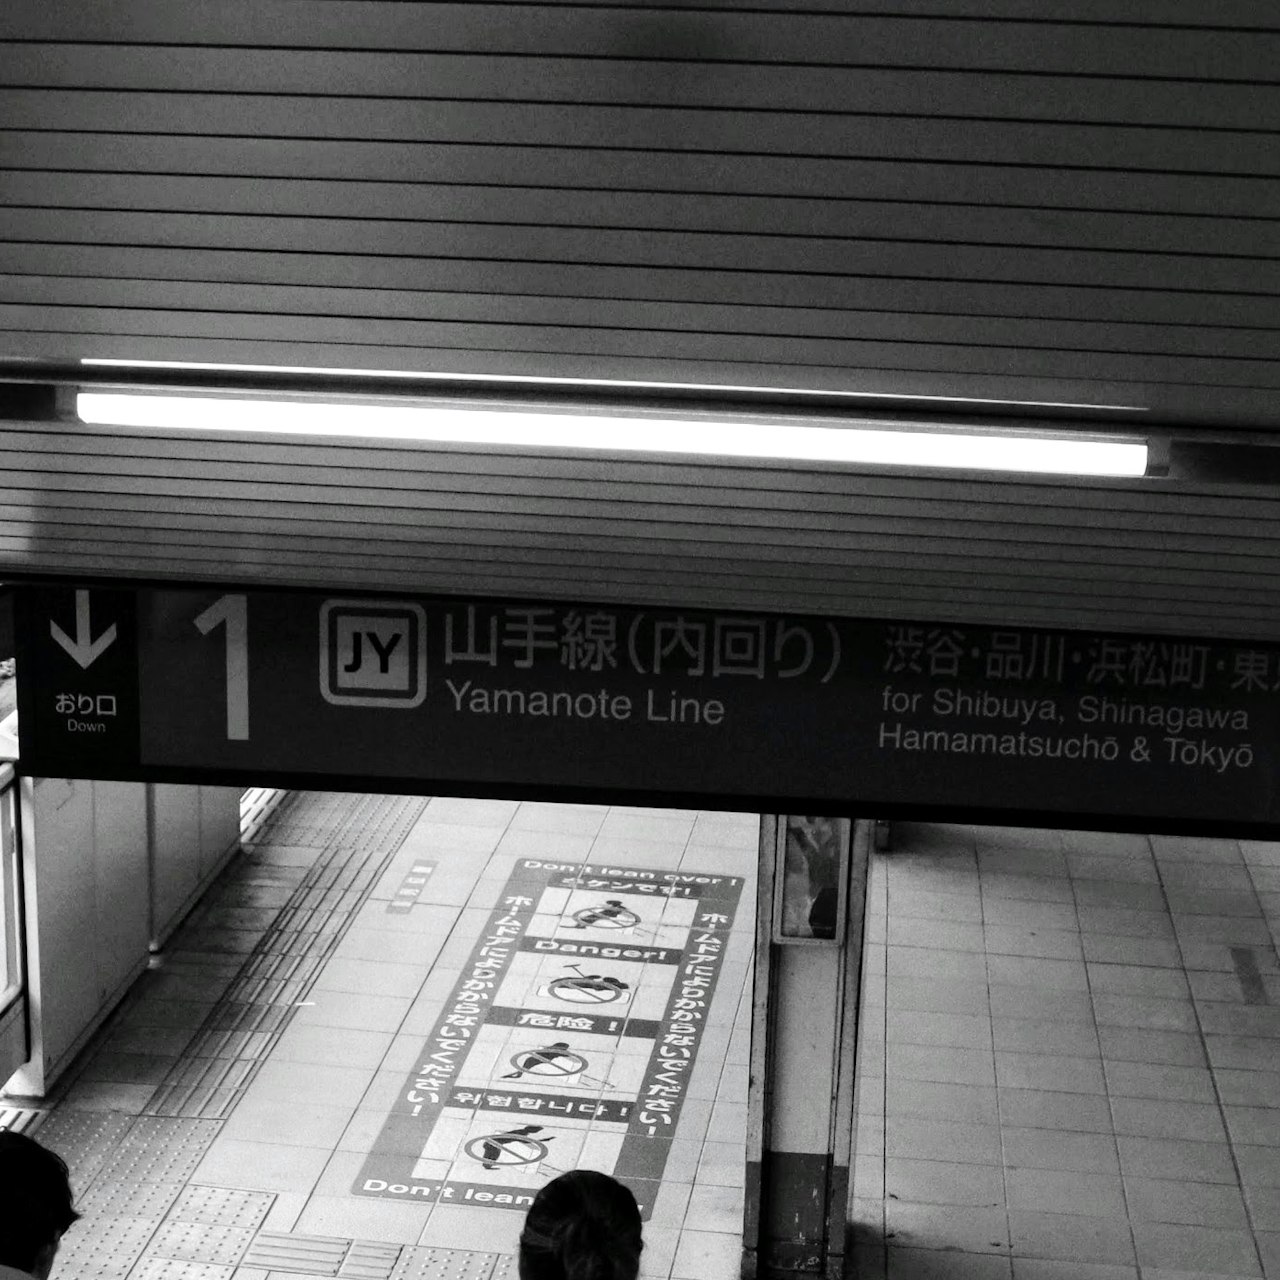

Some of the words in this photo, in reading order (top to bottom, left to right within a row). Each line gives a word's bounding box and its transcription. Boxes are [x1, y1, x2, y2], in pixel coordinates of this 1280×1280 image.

[344, 632, 402, 674] JY
[444, 604, 842, 684] 山手線(内回り)
[193, 594, 250, 741] 1
[55, 693, 117, 717] おり口
[445, 678, 633, 721] Yamanote
[647, 689, 726, 726] Line
[881, 685, 923, 713] for
[932, 688, 1066, 727] Shibuya,
[1077, 695, 1250, 733] Shinagawa
[67, 718, 107, 734] Down
[879, 722, 1120, 762] Hamamatsuchō
[1130, 736, 1152, 763] &
[1164, 737, 1254, 774] Tōkyō
[524, 860, 593, 874] Don't
[601, 868, 655, 880] lean
[535, 940, 667, 962] Danger!
[363, 1179, 455, 1199] Don't
